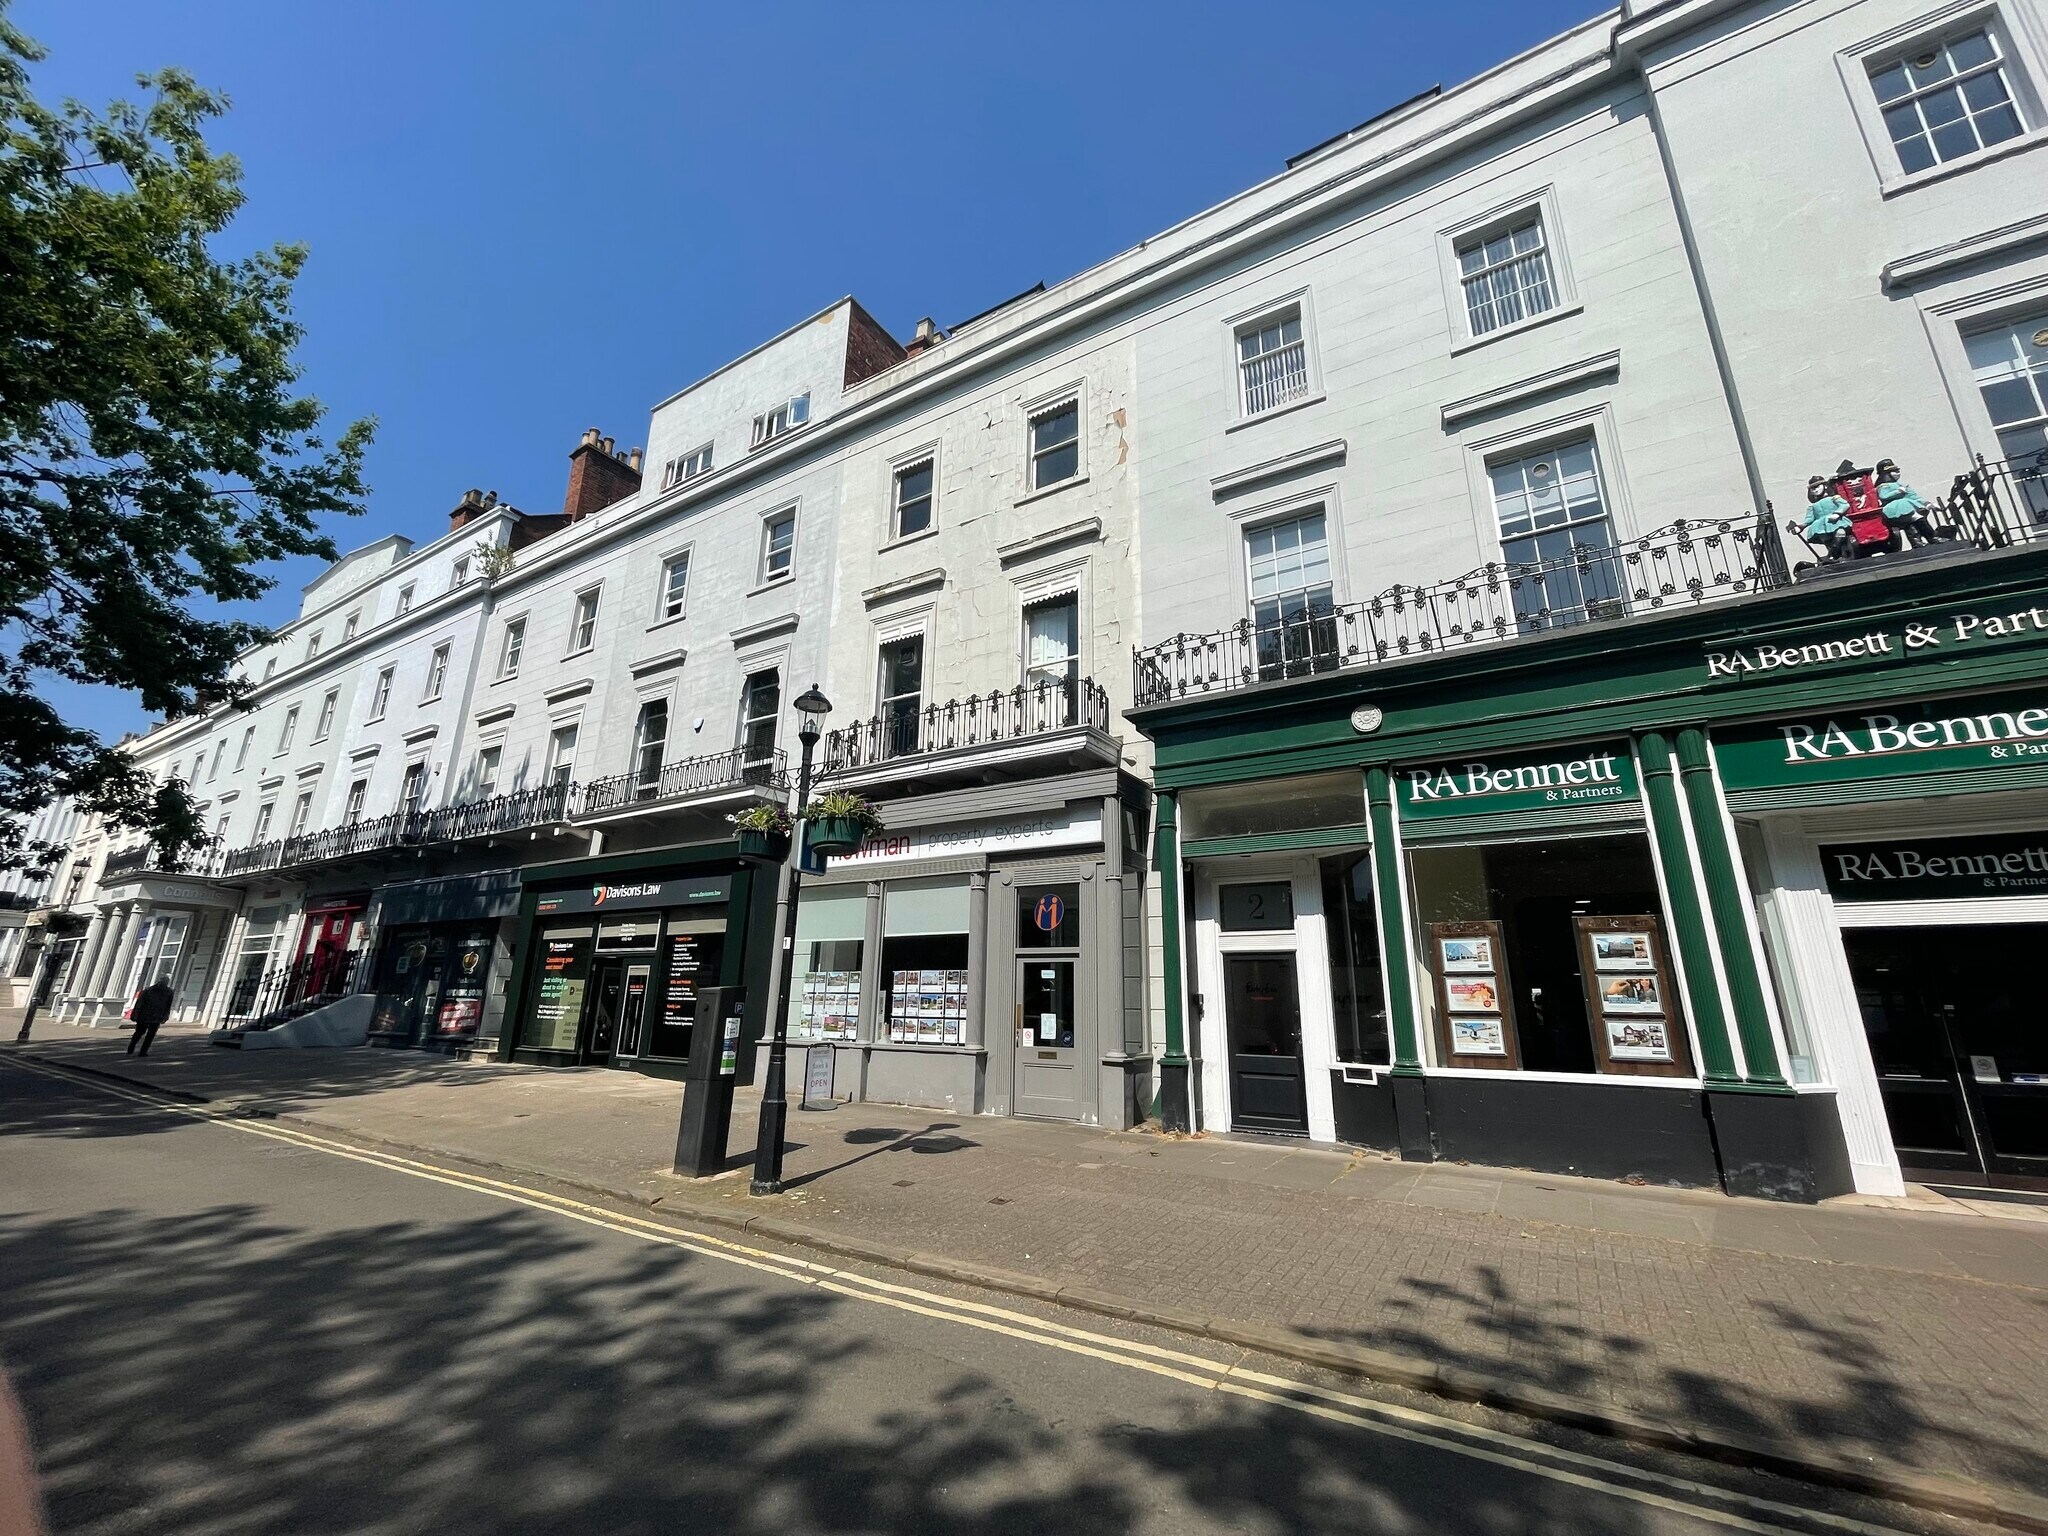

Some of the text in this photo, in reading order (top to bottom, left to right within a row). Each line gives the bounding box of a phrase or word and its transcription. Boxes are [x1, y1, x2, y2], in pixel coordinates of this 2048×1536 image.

[1704, 650, 1756, 678] RA
[1754, 630, 1893, 669] Bennett
[1904, 621, 1941, 648] &
[1777, 720, 1865, 762] RA
[1990, 745, 2009, 759] &
[1407, 751, 1620, 801] RA Bennett
[1546, 786, 1623, 801] & Partners
[928, 827, 986, 851] property
[995, 820, 1054, 844] experts
[1833, 846, 2048, 882] RA Bennett
[606, 882, 662, 899] Davisons Law
[1983, 877, 1997, 888] &
[164, 885, 223, 900] Connells
[1248, 893, 1265, 920] 2
[446, 988, 483, 997] OPENING SOON
[811, 1079, 828, 1088] OPEN
